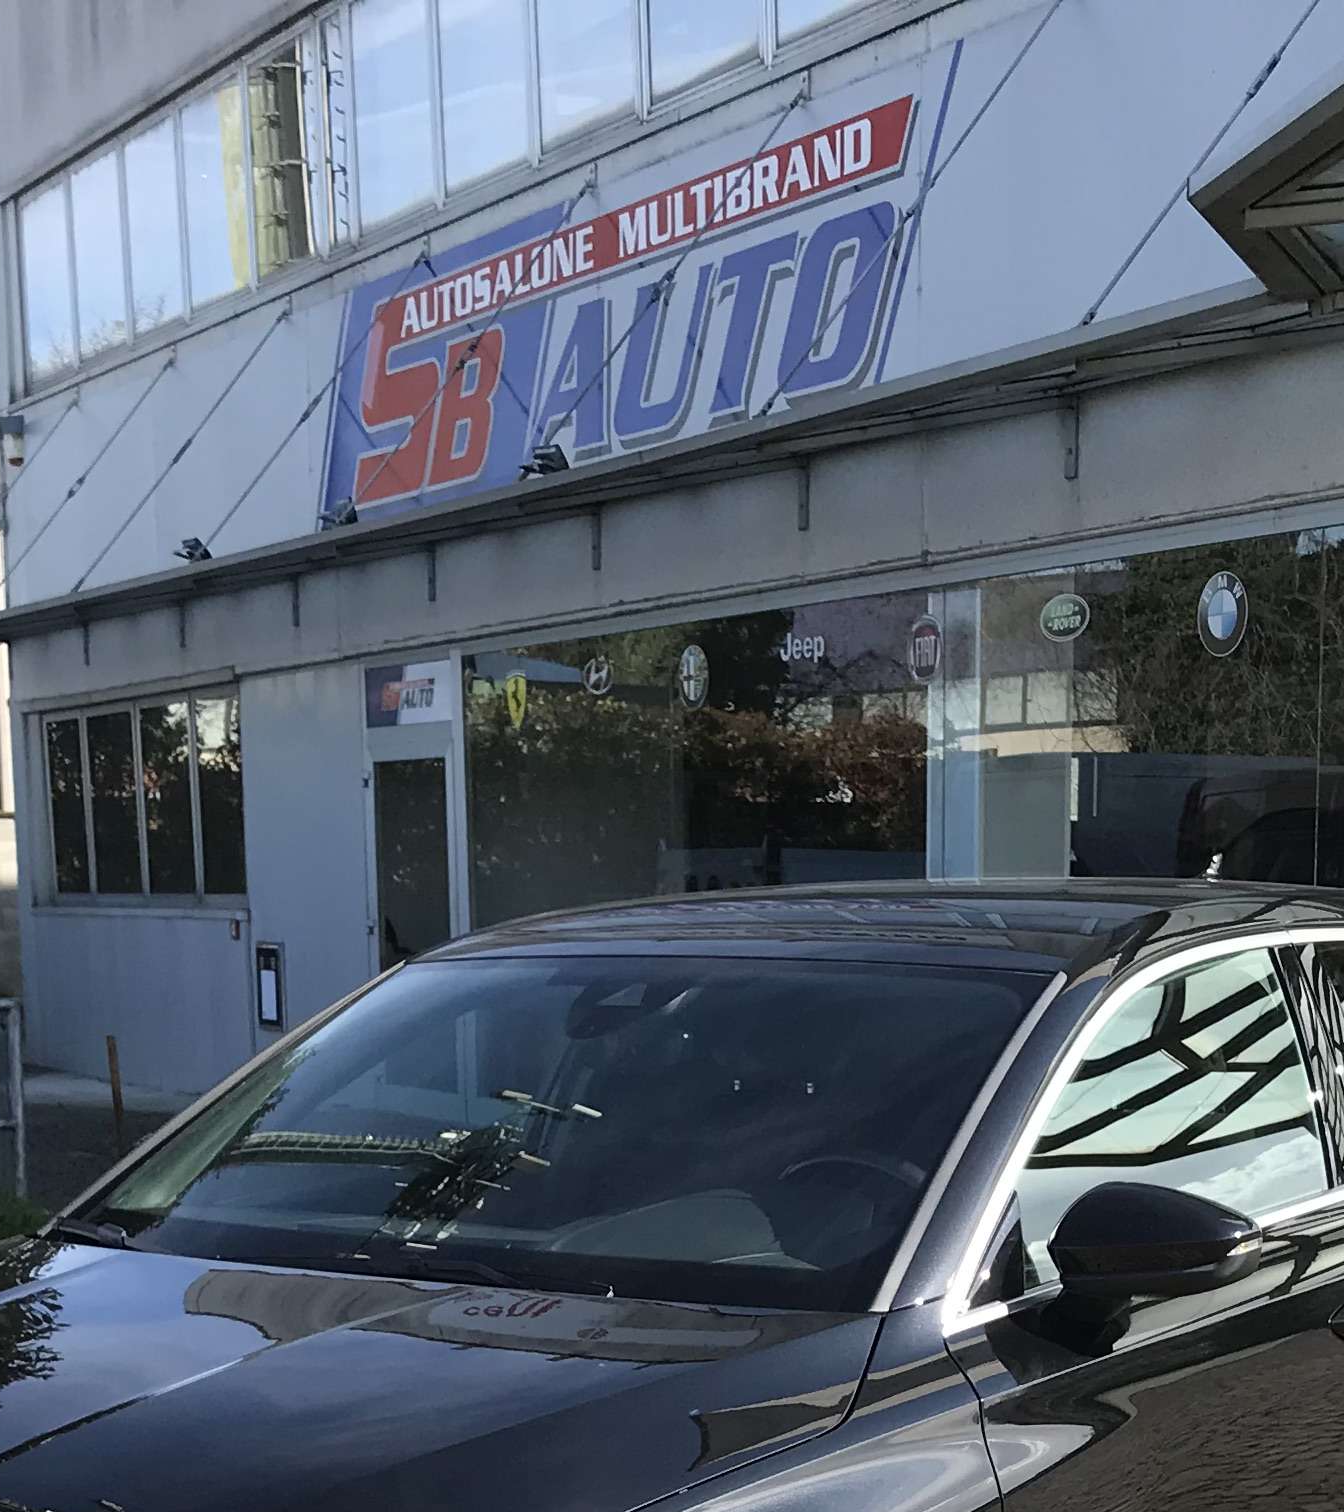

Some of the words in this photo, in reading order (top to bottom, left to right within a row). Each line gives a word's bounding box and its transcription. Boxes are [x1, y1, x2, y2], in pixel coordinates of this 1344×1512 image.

[399, 224, 595, 339] AUTOSALONE
[616, 116, 873, 260] MULTIBRAND
[534, 200, 904, 457] AUTO
[780, 632, 825, 663] Jeep
[914, 635, 936, 667] FIAT
[400, 688, 434, 710] AUTO
